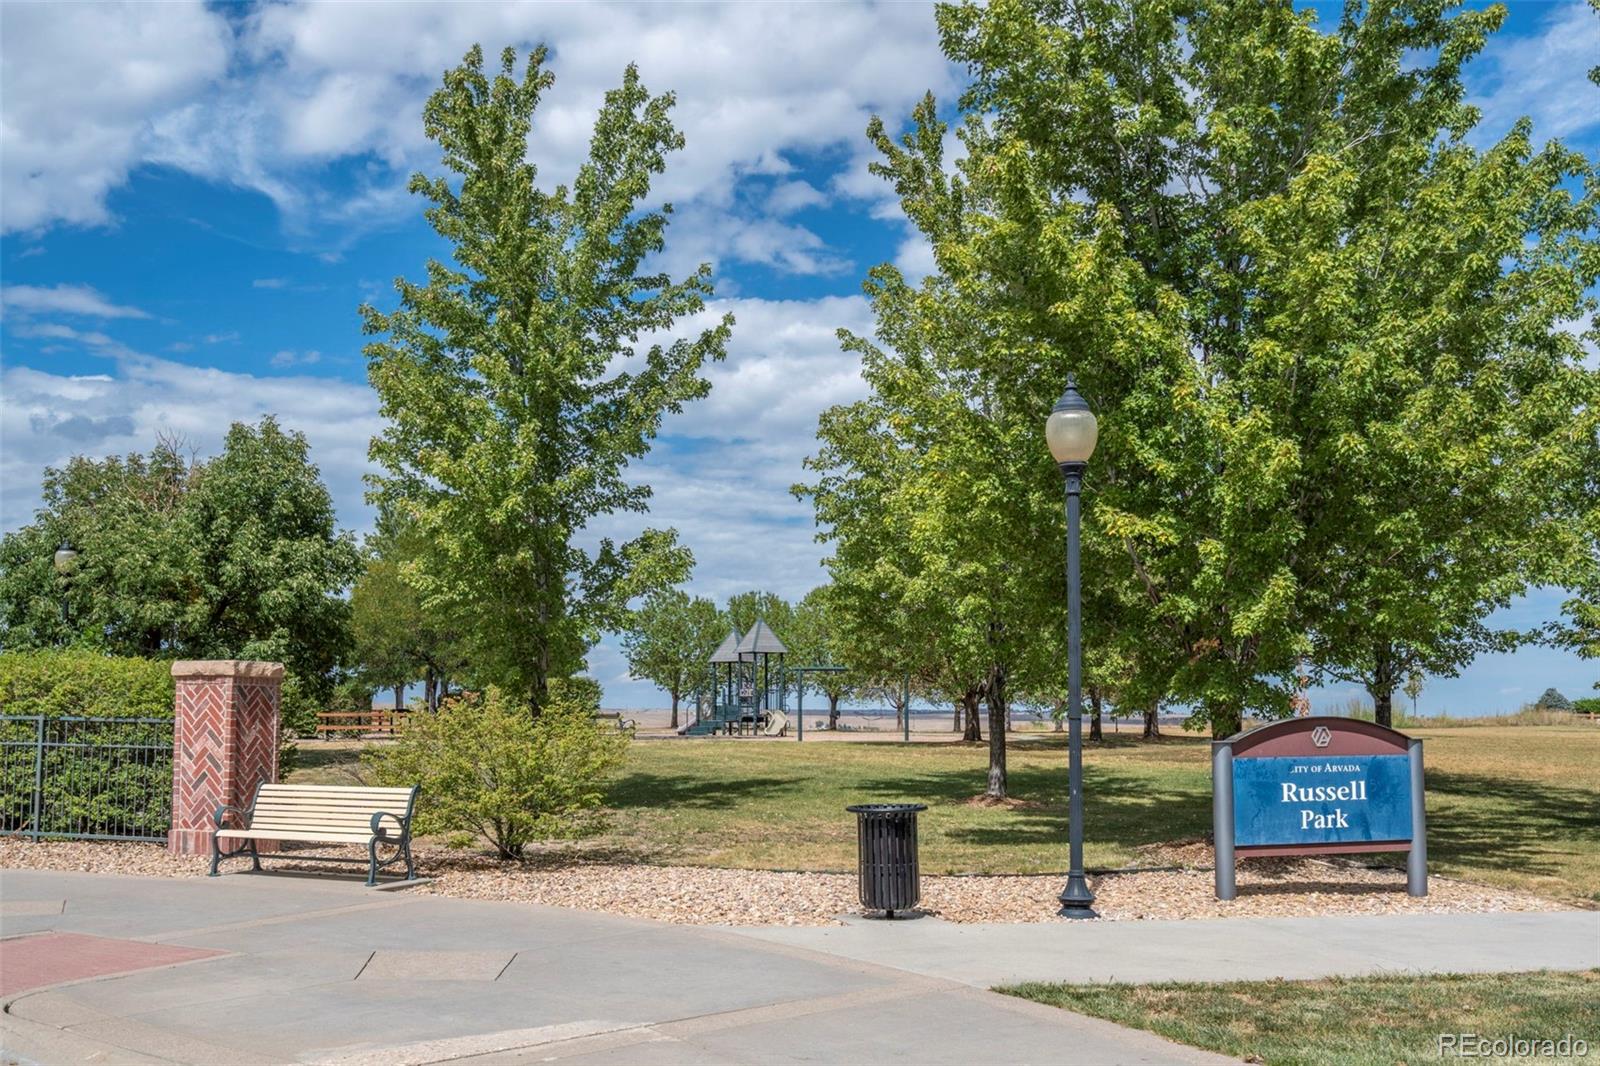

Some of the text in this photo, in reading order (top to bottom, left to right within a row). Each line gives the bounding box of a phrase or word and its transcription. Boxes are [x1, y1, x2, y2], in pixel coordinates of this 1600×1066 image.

[1290, 765, 1308, 774] ITY
[1281, 780, 1366, 803] Russell
[1300, 808, 1349, 830] Park
